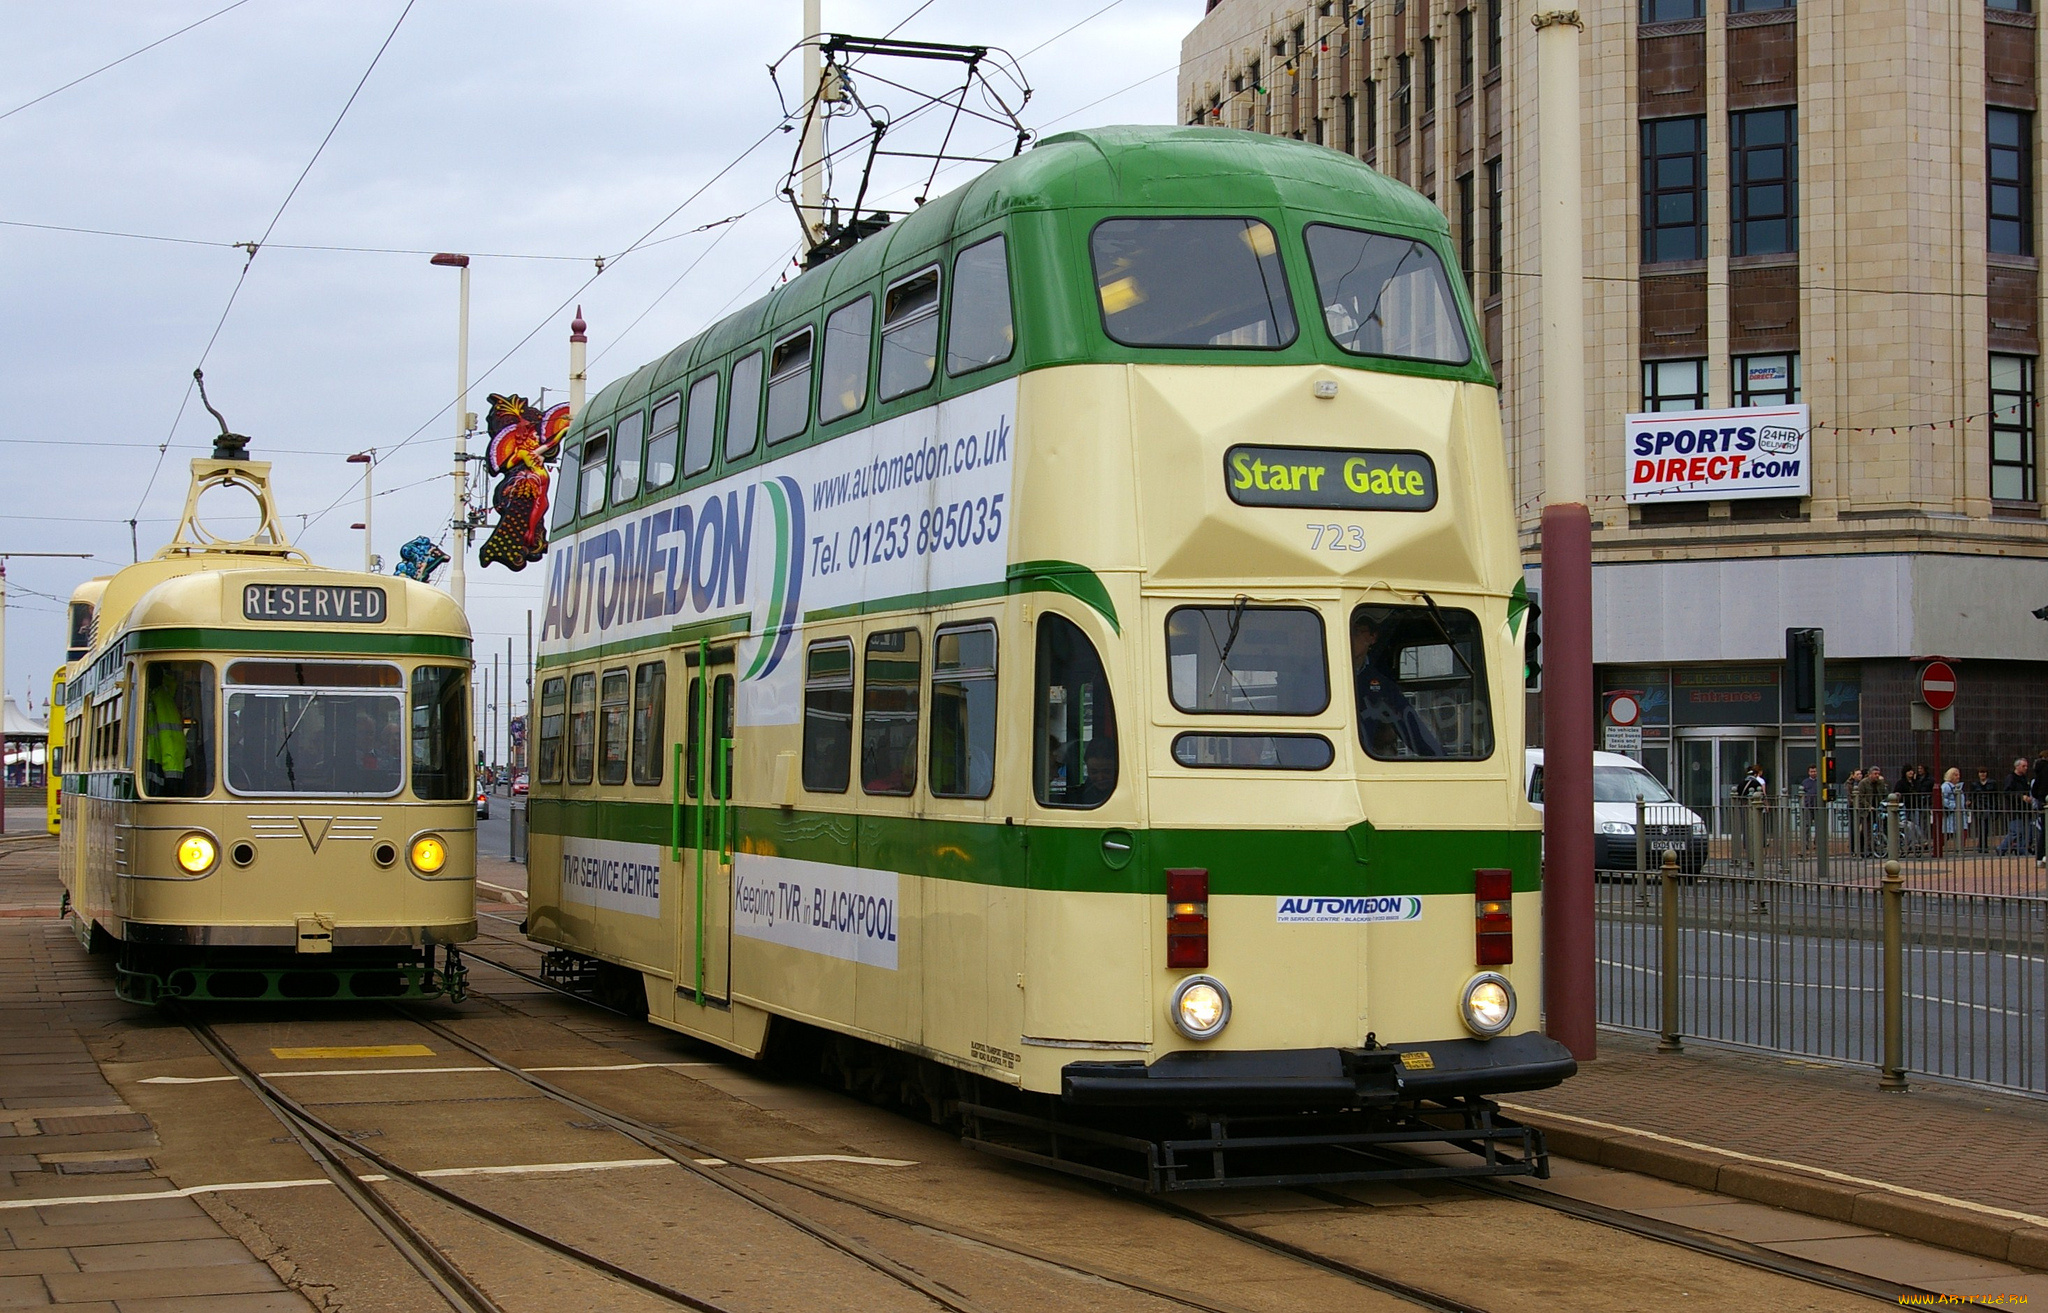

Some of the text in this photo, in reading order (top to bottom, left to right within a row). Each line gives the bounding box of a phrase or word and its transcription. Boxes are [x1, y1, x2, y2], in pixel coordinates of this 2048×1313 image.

[1633, 426, 1757, 456] SPORTS
[1763, 429, 1796, 441] 24HR
[813, 414, 1011, 512] www.automedon.co.uk
[1232, 452, 1425, 496] Starr Gate
[812, 493, 1004, 577] Tel. 01253 895035
[1306, 523, 1367, 552] 723
[541, 483, 756, 642] AUTOMEDON
[246, 587, 380, 618] RESERVED
[1689, 690, 1762, 703] Entrance
[563, 855, 660, 898] TVR SERVICE CENTRE
[735, 876, 896, 942] Keeping TVR in BLACKPOOL
[1278, 897, 1402, 914] AUTOMEDON
